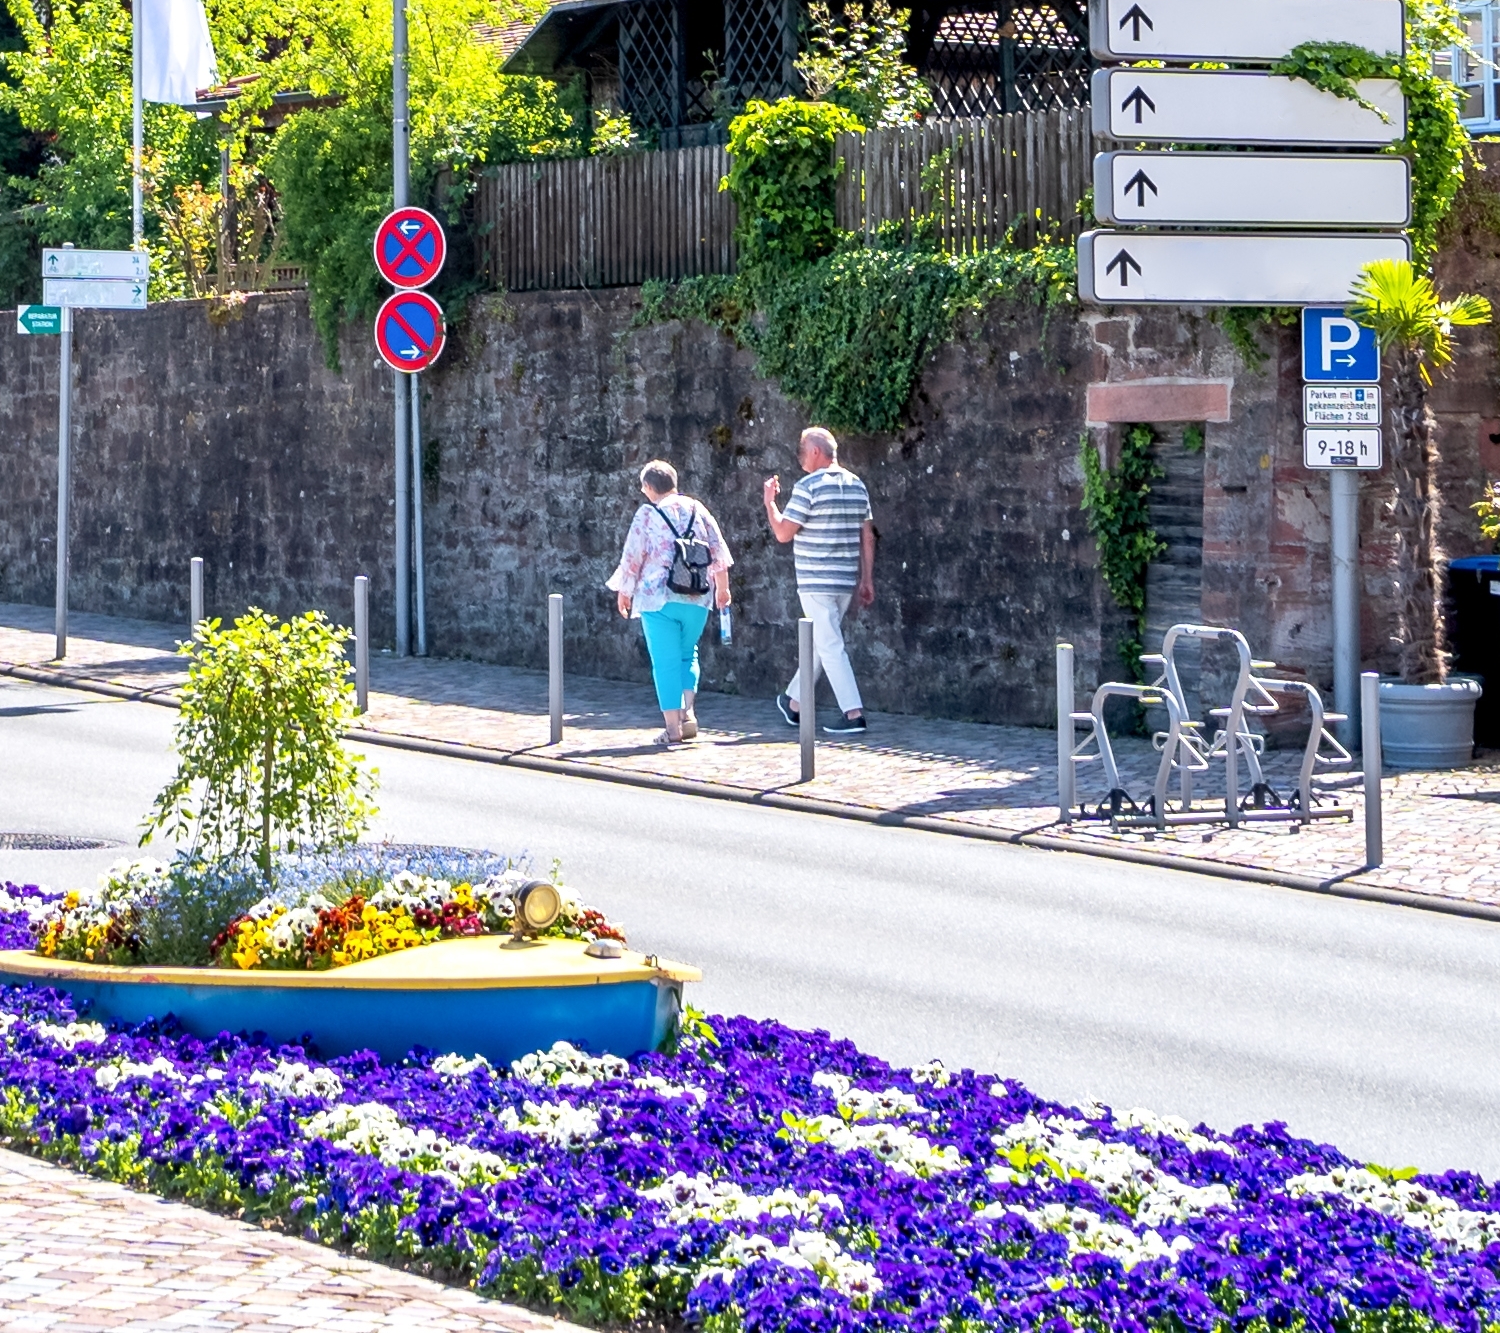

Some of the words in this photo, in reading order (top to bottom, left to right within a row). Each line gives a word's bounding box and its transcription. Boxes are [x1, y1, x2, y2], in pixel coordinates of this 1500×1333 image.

[1321, 317, 1361, 371] P
[1310, 390, 1337, 399] Parken
[1340, 389, 1353, 399] mit
[1366, 390, 1375, 399] in
[1309, 402, 1376, 411] gekennzeichneten
[1315, 412, 1344, 421] Flächen
[1347, 412, 1352, 420] 2
[1355, 412, 1370, 421] Std.
[1318, 440, 1355, 456] 9-18
[1360, 440, 1368, 456] h
